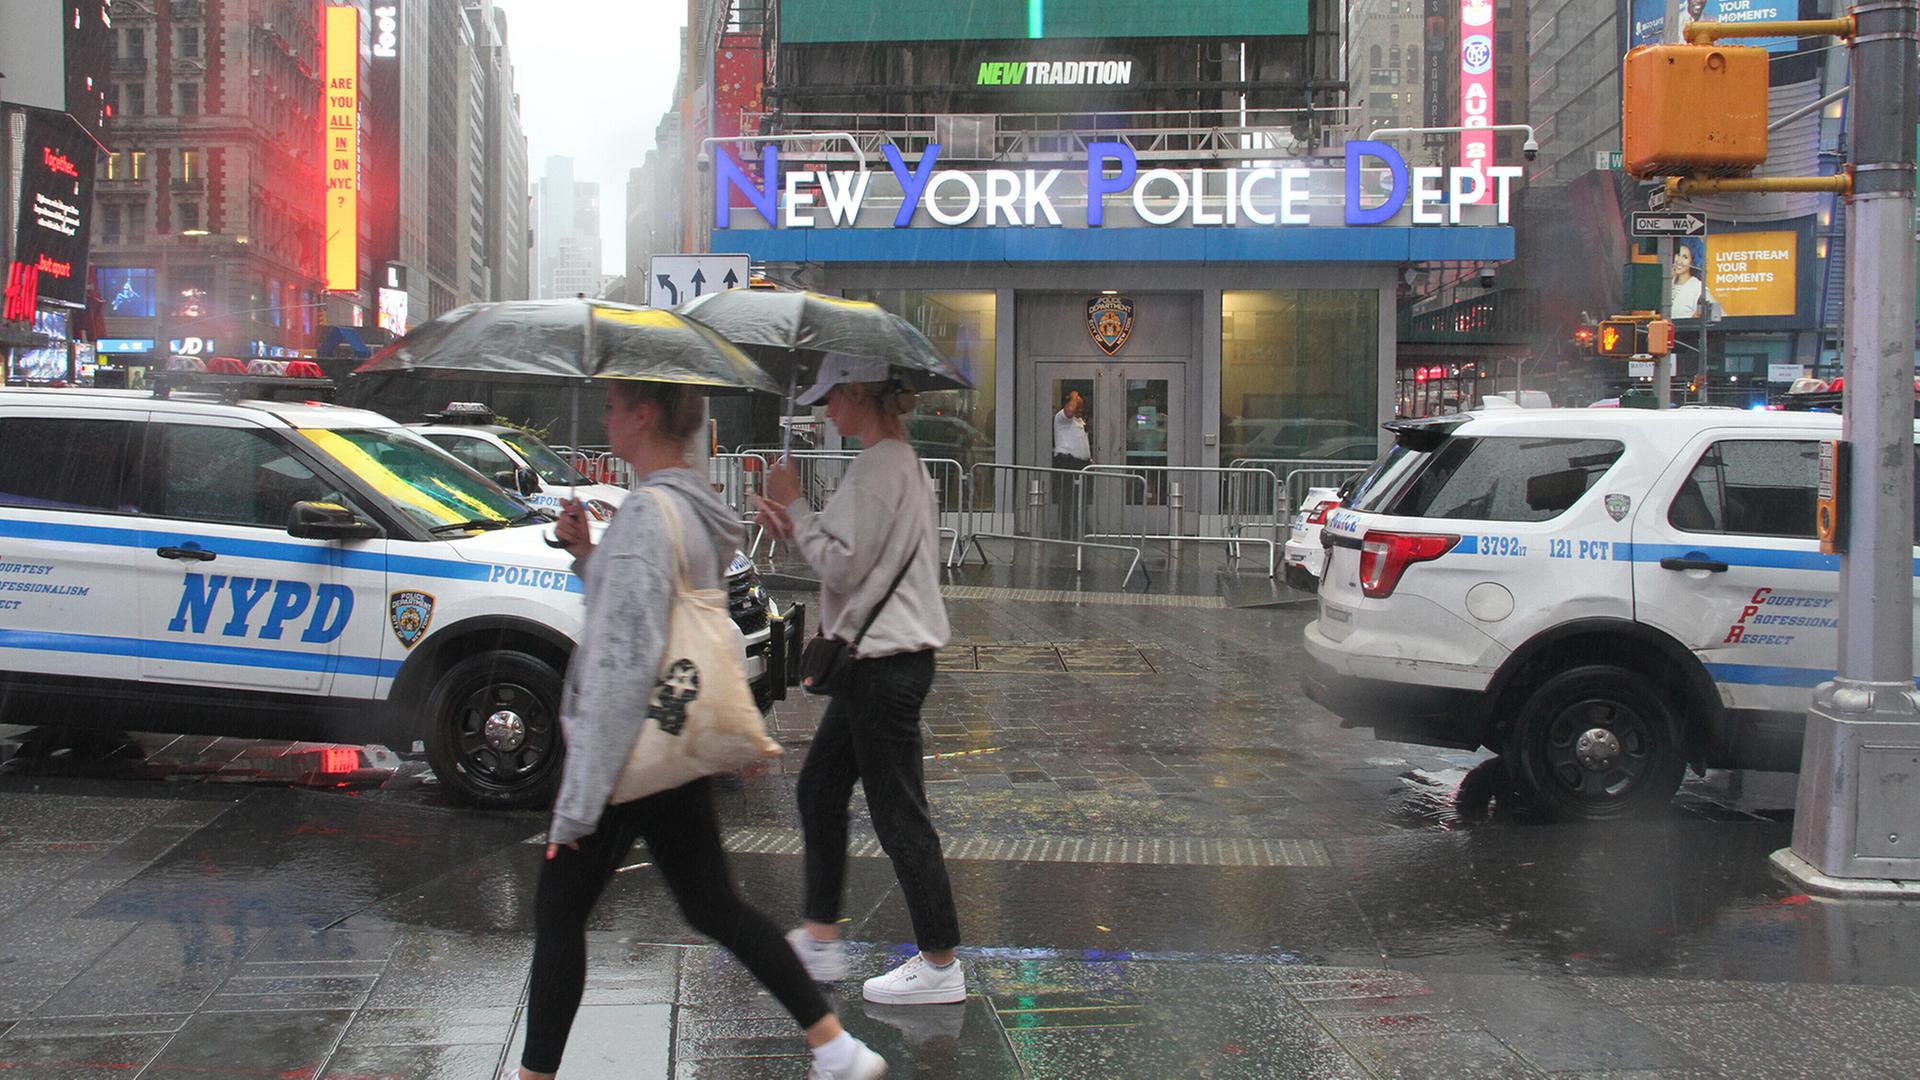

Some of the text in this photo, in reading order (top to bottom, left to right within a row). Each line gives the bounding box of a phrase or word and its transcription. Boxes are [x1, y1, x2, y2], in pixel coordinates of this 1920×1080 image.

[1718, 1, 1750, 12] YOUR
[1718, 8, 1777, 23] MOMENTS
[330, 78, 352, 89] ARE
[330, 97, 353, 108] YOU
[1465, 83, 1487, 128] AUG
[330, 116, 353, 127] ALL
[335, 137, 347, 148] IN
[333, 159, 349, 170] ON
[330, 178, 353, 189] NYC
[715, 140, 1523, 229] NEW YORK POLICE DEPT
[337, 197, 345, 208] ?
[1638, 219, 1696, 229] ONE WAY
[1715, 250, 1789, 262] LIVESTREAM
[1716, 262, 1748, 273] YOUR
[1715, 272, 1774, 284] MOMENTS
[178, 337, 203, 355] JD
[1549, 538, 1609, 561] 121 PCT
[0, 562, 54, 575] OURTESY
[490, 565, 565, 591] POLICE
[1751, 587, 1833, 608] COURTESY
[167, 572, 355, 644] NYPD
[1737, 605, 1839, 629] PROFESSIONA
[1723, 625, 1795, 645] RESPECT
